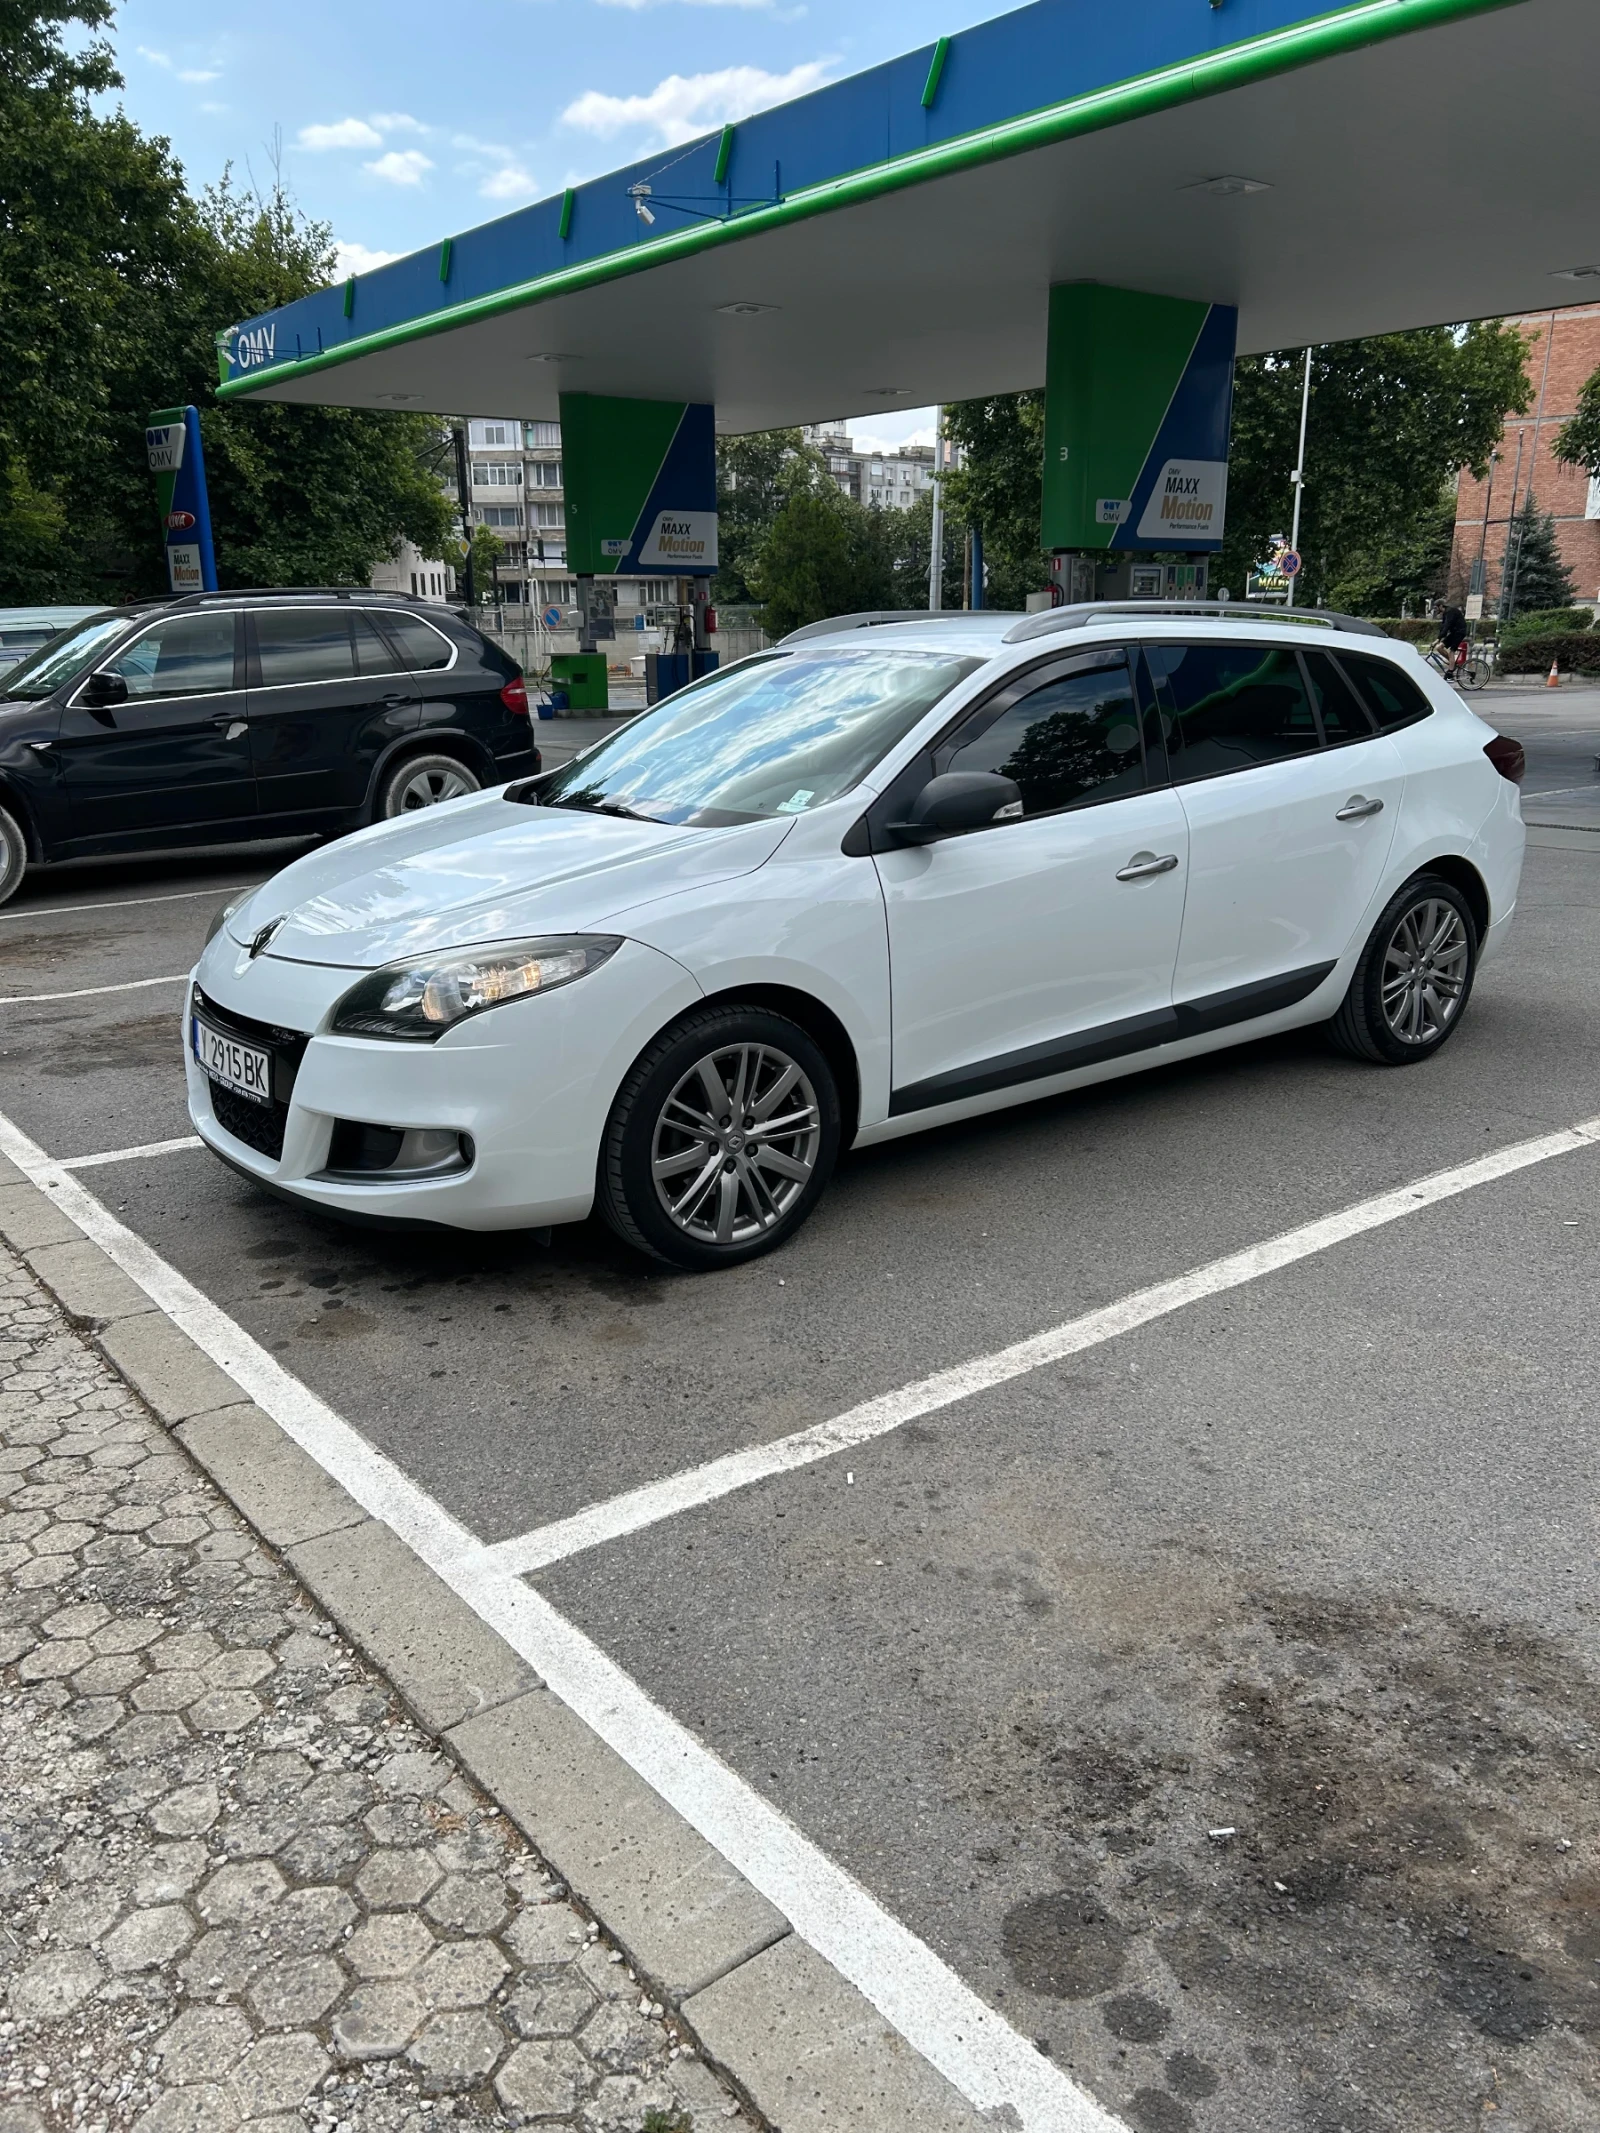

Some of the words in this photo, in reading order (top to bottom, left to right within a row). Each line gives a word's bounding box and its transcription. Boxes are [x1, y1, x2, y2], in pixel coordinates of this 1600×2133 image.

[238, 323, 275, 369] OMV
[150, 450, 173, 467] OMV
[1060, 446, 1069, 461] 3
[1168, 467, 1181, 475] OMV
[1165, 477, 1200, 494] MAXX
[571, 504, 578, 515] 5
[1160, 495, 1213, 521] Motion
[1103, 512, 1120, 521] OMV
[660, 522, 691, 535] MAXX
[658, 535, 705, 553] Motion
[174, 553, 190, 564] MAXX
[174, 565, 199, 581] Motion
[200, 1027, 207, 1059] Y
[211, 1035, 242, 1080] 2915
[243, 1050, 267, 1092] BK
